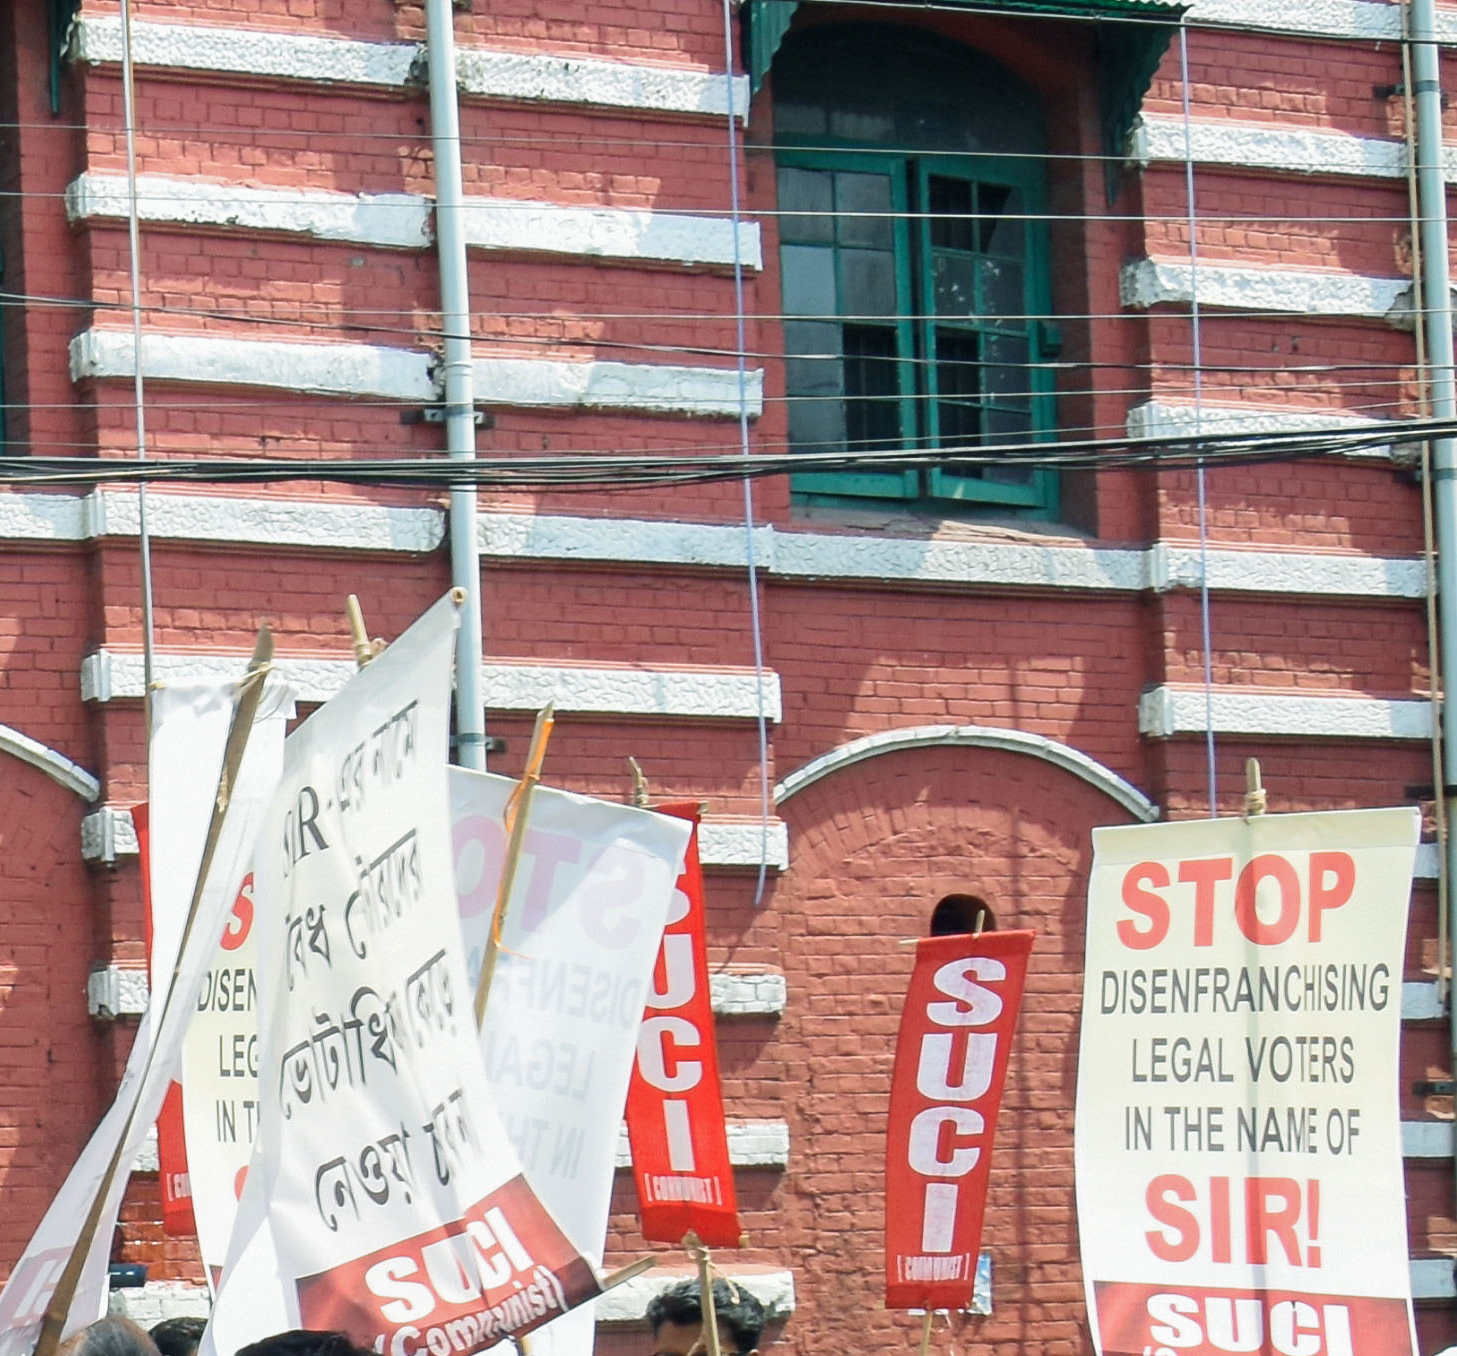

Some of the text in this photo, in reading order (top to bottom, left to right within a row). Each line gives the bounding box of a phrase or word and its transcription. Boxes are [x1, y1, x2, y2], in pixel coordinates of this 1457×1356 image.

[1114, 850, 1357, 951] STOP
[1099, 962, 1391, 1016] DISENFRANCHISING
[907, 955, 1008, 1254] SUCI
[1131, 1034, 1356, 1086] LEGAL VOTERS
[1124, 1105, 1362, 1157] IN THE NAME OF
[363, 1205, 535, 1325] SUCI
[1143, 1172, 1323, 1271] SIR!
